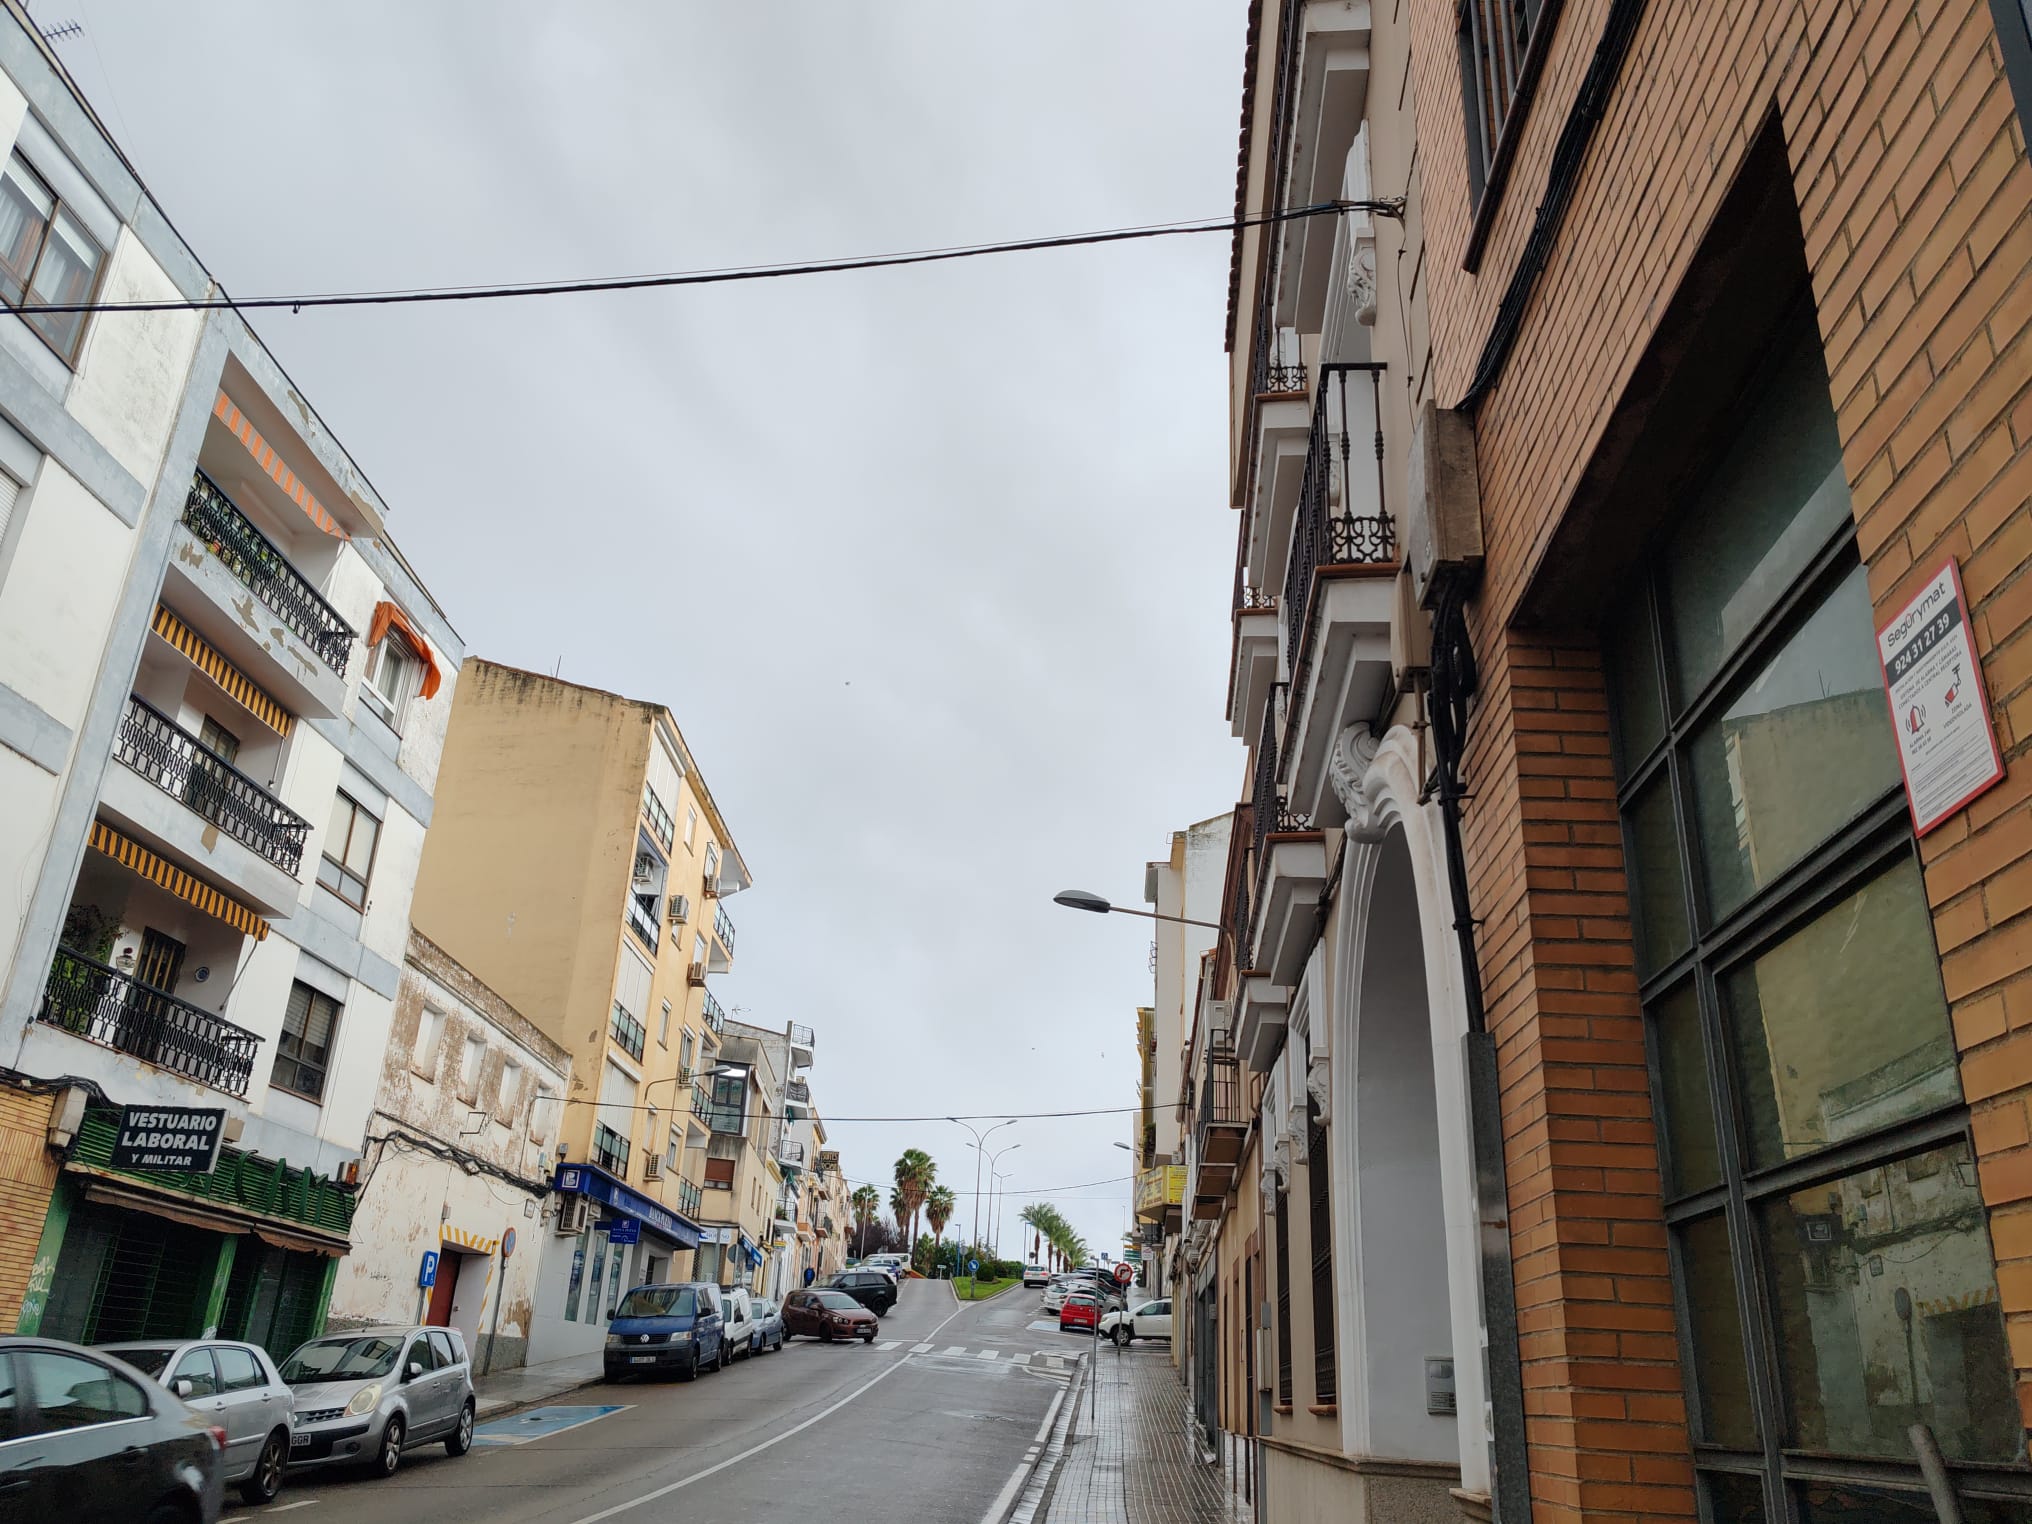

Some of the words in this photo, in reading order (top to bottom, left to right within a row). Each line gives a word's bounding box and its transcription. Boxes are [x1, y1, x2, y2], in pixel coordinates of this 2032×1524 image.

[1895, 654, 1912, 675] 924
[1911, 640, 1924, 659] 31
[1924, 628, 1937, 648] 27
[1936, 612, 1950, 635] 39
[129, 1112, 217, 1131] VESTUARIO
[121, 1131, 210, 1151] LABORAL
[131, 1153, 140, 1164] Y
[142, 1154, 192, 1166] MILITAR
[424, 1255, 435, 1282] P
